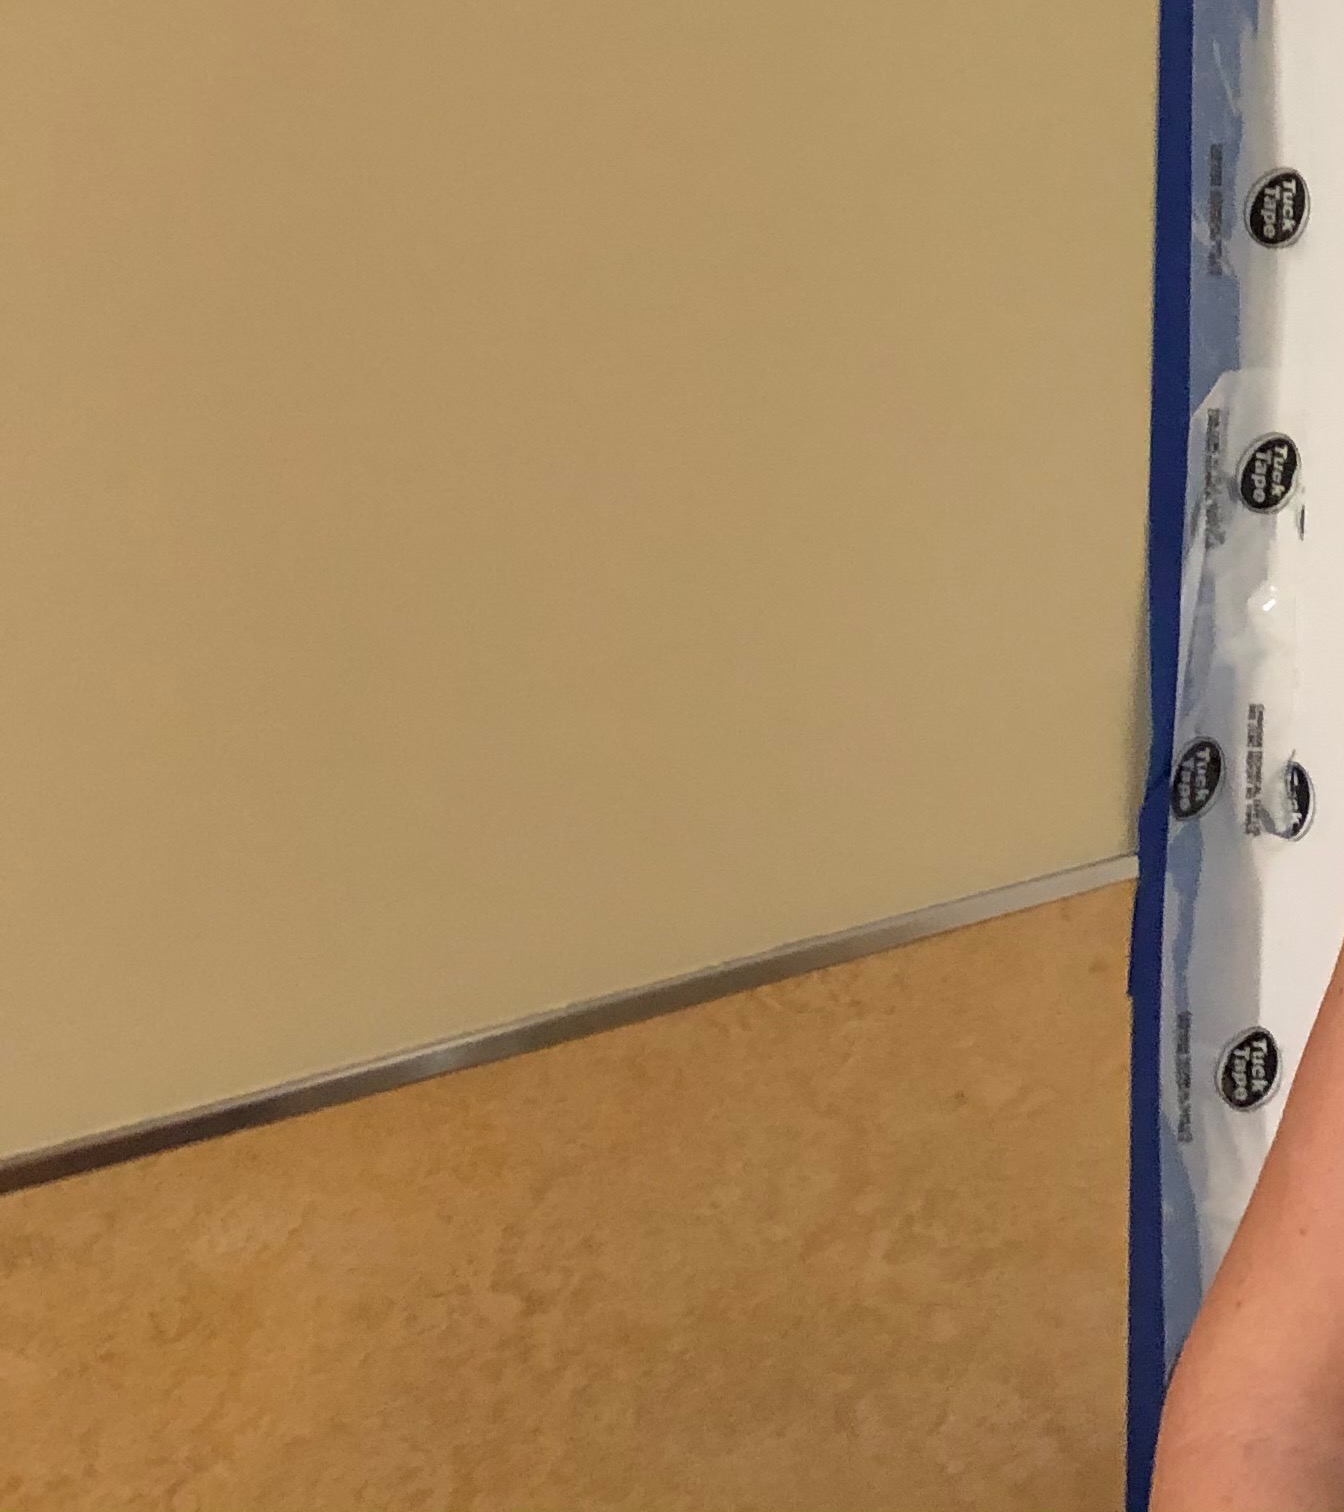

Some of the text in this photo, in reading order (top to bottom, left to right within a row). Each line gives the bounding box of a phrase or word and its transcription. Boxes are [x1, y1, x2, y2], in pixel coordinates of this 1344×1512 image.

[1262, 186, 1280, 238] Tape
[1279, 179, 1297, 234] Tuck
[1251, 450, 1272, 504] Tape
[1269, 444, 1289, 498] Tuck
[1230, 1044, 1251, 1103] Tape
[1249, 1036, 1269, 1094] Tuck
